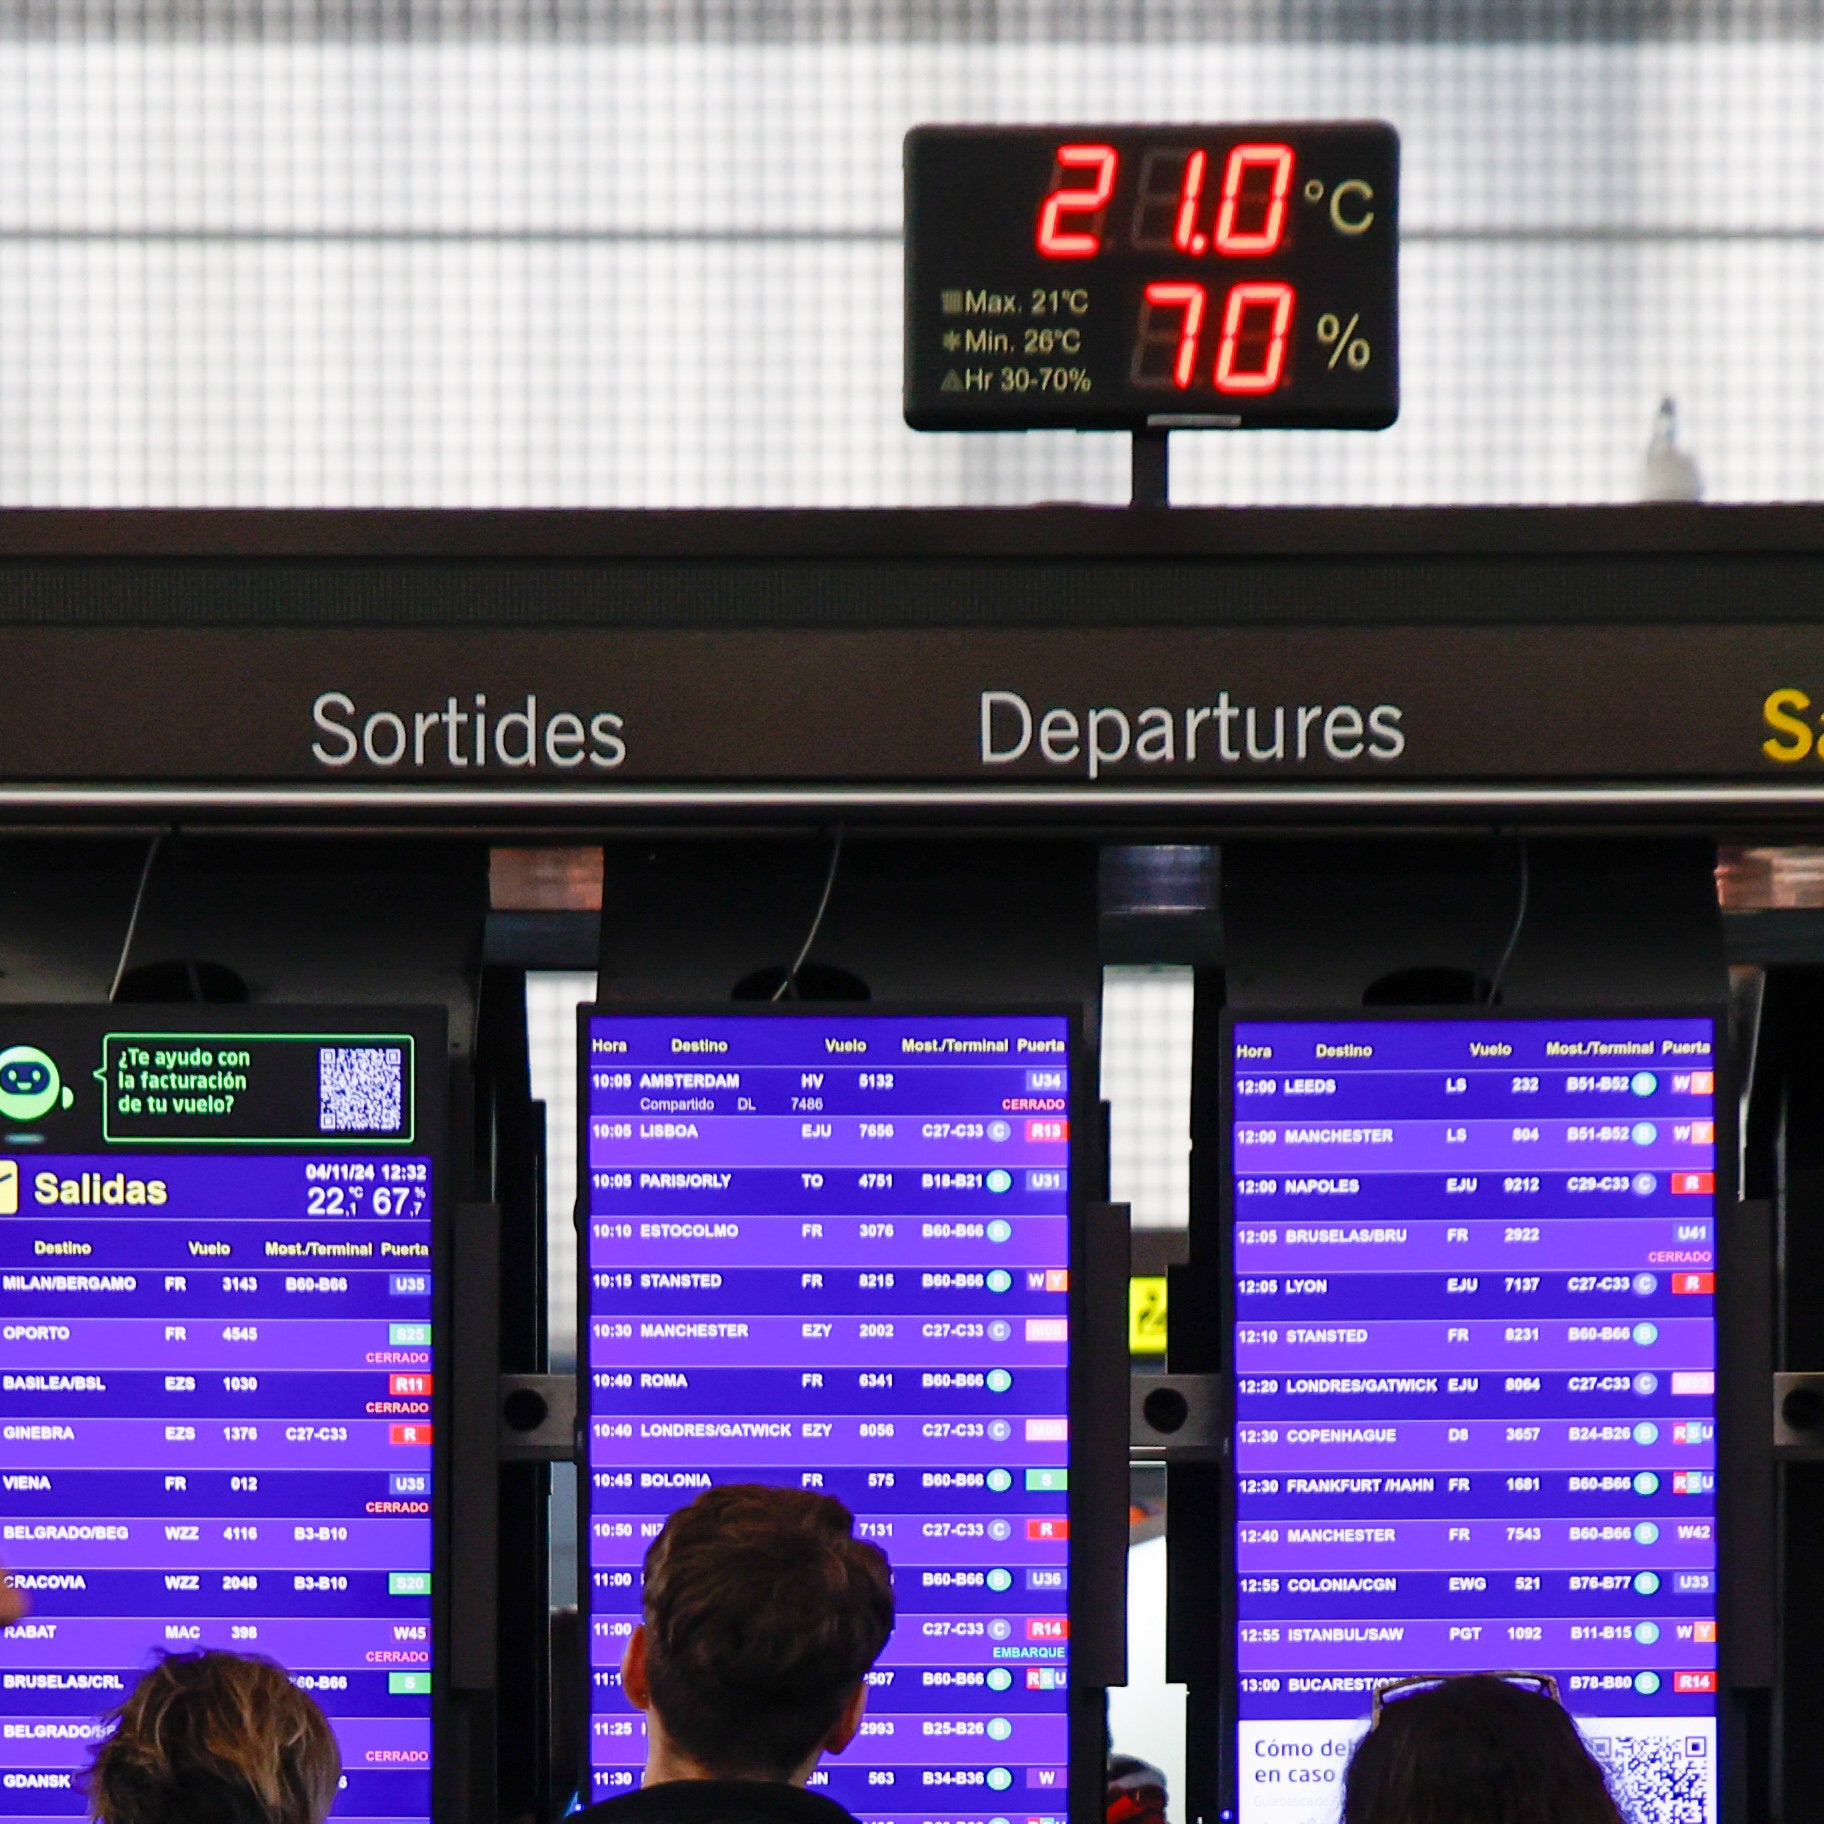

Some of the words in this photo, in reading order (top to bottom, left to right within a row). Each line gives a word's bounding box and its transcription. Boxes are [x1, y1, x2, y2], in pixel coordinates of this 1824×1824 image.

[1303, 179, 1376, 235] °C
[965, 291, 1022, 314] Max.
[1032, 290, 1089, 314] 21°C
[965, 330, 1014, 353] Min.
[1024, 329, 1082, 354] 26°C
[1144, 283, 1296, 394] 70
[1316, 313, 1371, 370] %
[965, 369, 993, 391] Hr
[1001, 368, 1091, 392] 30-70%
[311, 692, 626, 767] Sortides
[981, 691, 1405, 779] Departures
[592, 1038, 627, 1053] Hora
[671, 1038, 728, 1053] Destino
[824, 1038, 867, 1053] Vuelo
[901, 1038, 1009, 1053] Most./Terminal
[1017, 1038, 1065, 1052] Puerta
[1236, 1044, 1272, 1059] Hora
[1315, 1043, 1373, 1058] Destino
[1469, 1042, 1513, 1057] Vuelo
[1546, 1040, 1655, 1056] Most./Terminal
[1662, 1040, 1711, 1055] Puerta
[118, 1047, 150, 1069] ¿Te
[154, 1047, 213, 1070] ayudo
[217, 1051, 250, 1067] con
[118, 1070, 135, 1090] la
[140, 1070, 247, 1090] facturación
[639, 1073, 740, 1089] AMSTERDAM
[1236, 1079, 1277, 1095] 12:00
[1284, 1078, 1337, 1095] LEEDS
[118, 1094, 142, 1113] de
[146, 1096, 168, 1113] tu
[172, 1094, 235, 1113] vuelo?
[639, 1097, 715, 1114] Compartido
[737, 1096, 757, 1111] DL
[1002, 1098, 1066, 1111] CERRADO
[640, 1123, 699, 1139] LISBOA
[1237, 1129, 1277, 1145] 12:00
[1284, 1128, 1394, 1144] MANCHESTER
[305, 1163, 375, 1181] 04/11/24
[381, 1163, 427, 1181] 12:32
[34, 1172, 168, 1205] Salidas
[639, 1173, 732, 1189] PARIS/ORLY
[1237, 1179, 1277, 1195] 12:00
[1284, 1178, 1360, 1194] NAPOLES
[640, 1223, 739, 1238] ESTOCOLMO
[1238, 1229, 1278, 1245] 12:05
[1285, 1228, 1407, 1244] BRUSELAS/BRU
[34, 1240, 92, 1255] Destino
[188, 1241, 231, 1256] Vuelo
[265, 1241, 373, 1256] Most./Terminal
[380, 1242, 429, 1256] Puerta
[2, 1275, 137, 1291] MILAN/BERGAMO
[640, 1273, 722, 1289] STANSTED
[1238, 1279, 1278, 1295] 12:05
[1285, 1279, 1328, 1294] LYON
[2, 1325, 71, 1341] OPORTO
[593, 1323, 633, 1338] 10:30
[640, 1323, 749, 1338] MANCHESTER
[1238, 1329, 1279, 1344] 12:10
[1286, 1328, 1368, 1344] STANSTED
[2, 1375, 106, 1391] BASILEA/BSL
[592, 1373, 633, 1388] 10:40
[640, 1373, 688, 1388] ROMA
[1238, 1379, 1279, 1394] 12:20
[1286, 1377, 1438, 1394] LONDRES/GATWICK
[3, 1425, 75, 1441] GINEBRA
[640, 1423, 792, 1438] LONDRES/GATWICK
[1239, 1429, 1279, 1444] 12:30
[1286, 1428, 1397, 1443] COPENHAGUE
[2, 1475, 52, 1491] VIENA
[640, 1473, 712, 1488] BOLONIA
[1239, 1479, 1279, 1494] 12:30
[1286, 1478, 1381, 1493] FRANKFURT
[3, 1525, 129, 1541] BELGRADO/BEG
[1240, 1529, 1279, 1543] 12:40
[1287, 1528, 1396, 1543] MANCHESTER
[3, 1574, 87, 1590] CRACOVIA
[1240, 1578, 1280, 1593] 12:55
[1287, 1577, 1397, 1593] COLONIA/CGN
[3, 1624, 57, 1639] RABAT
[1240, 1628, 1281, 1643] 12:55
[1288, 1627, 1405, 1642] ISTANBUL/SAW
[992, 1646, 1066, 1659] EMBARQUE
[3, 1674, 125, 1690] BRUSELAS/CRL
[1240, 1678, 1281, 1692] 13:00
[1255, 1739, 1313, 1757] Cómo
[3, 1773, 71, 1789] GDANSK
[1255, 1769, 1280, 1782] en
[1288, 1769, 1335, 1782] caso
